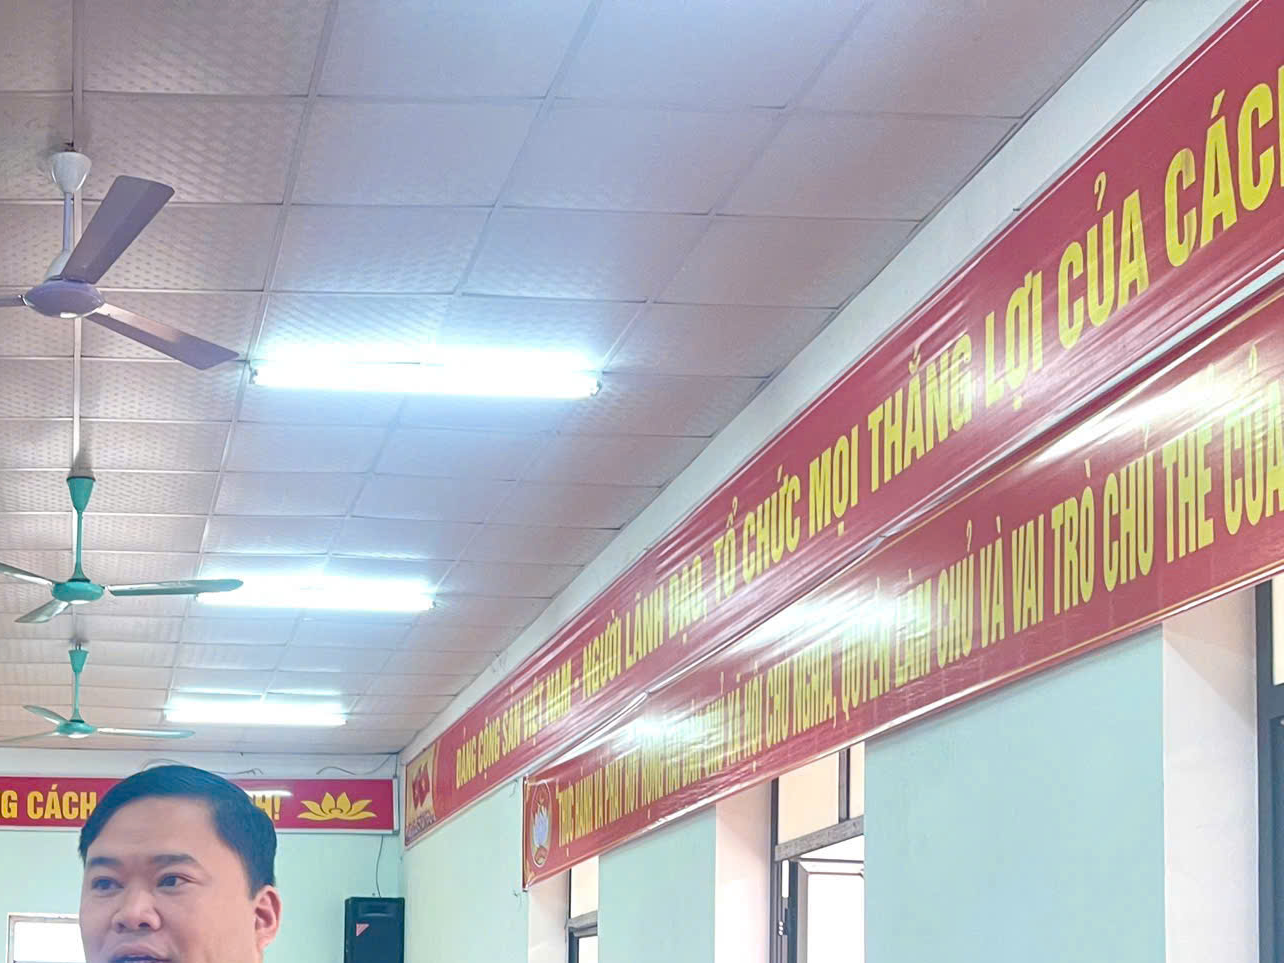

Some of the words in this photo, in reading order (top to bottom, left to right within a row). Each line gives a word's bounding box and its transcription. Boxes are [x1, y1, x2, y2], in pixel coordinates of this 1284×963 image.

[478, 716, 501, 780] CỘNG
[502, 685, 521, 756] SẢN
[523, 676, 544, 746] VIỆT
[546, 658, 572, 725] NAM
[583, 609, 622, 700] NGƯỜI
[625, 583, 664, 671] LÃNH
[713, 495, 738, 604] TỔ
[742, 464, 801, 585] CHỨC
[809, 424, 859, 539] MỌI
[867, 333, 973, 494] THẮNG
[984, 270, 1044, 412] LỢI
[1056, 171, 1150, 350] CỦA
[744, 660, 763, 772] HỘI
[895, 568, 932, 689] LÀM
[937, 519, 975, 669] CHỦ
[979, 515, 1005, 649] VÀ
[1011, 513, 1044, 635] VAI
[1051, 458, 1095, 616] TRÒ
[1103, 423, 1154, 592] CHỦ
[26, 783, 97, 820] CÁCH
